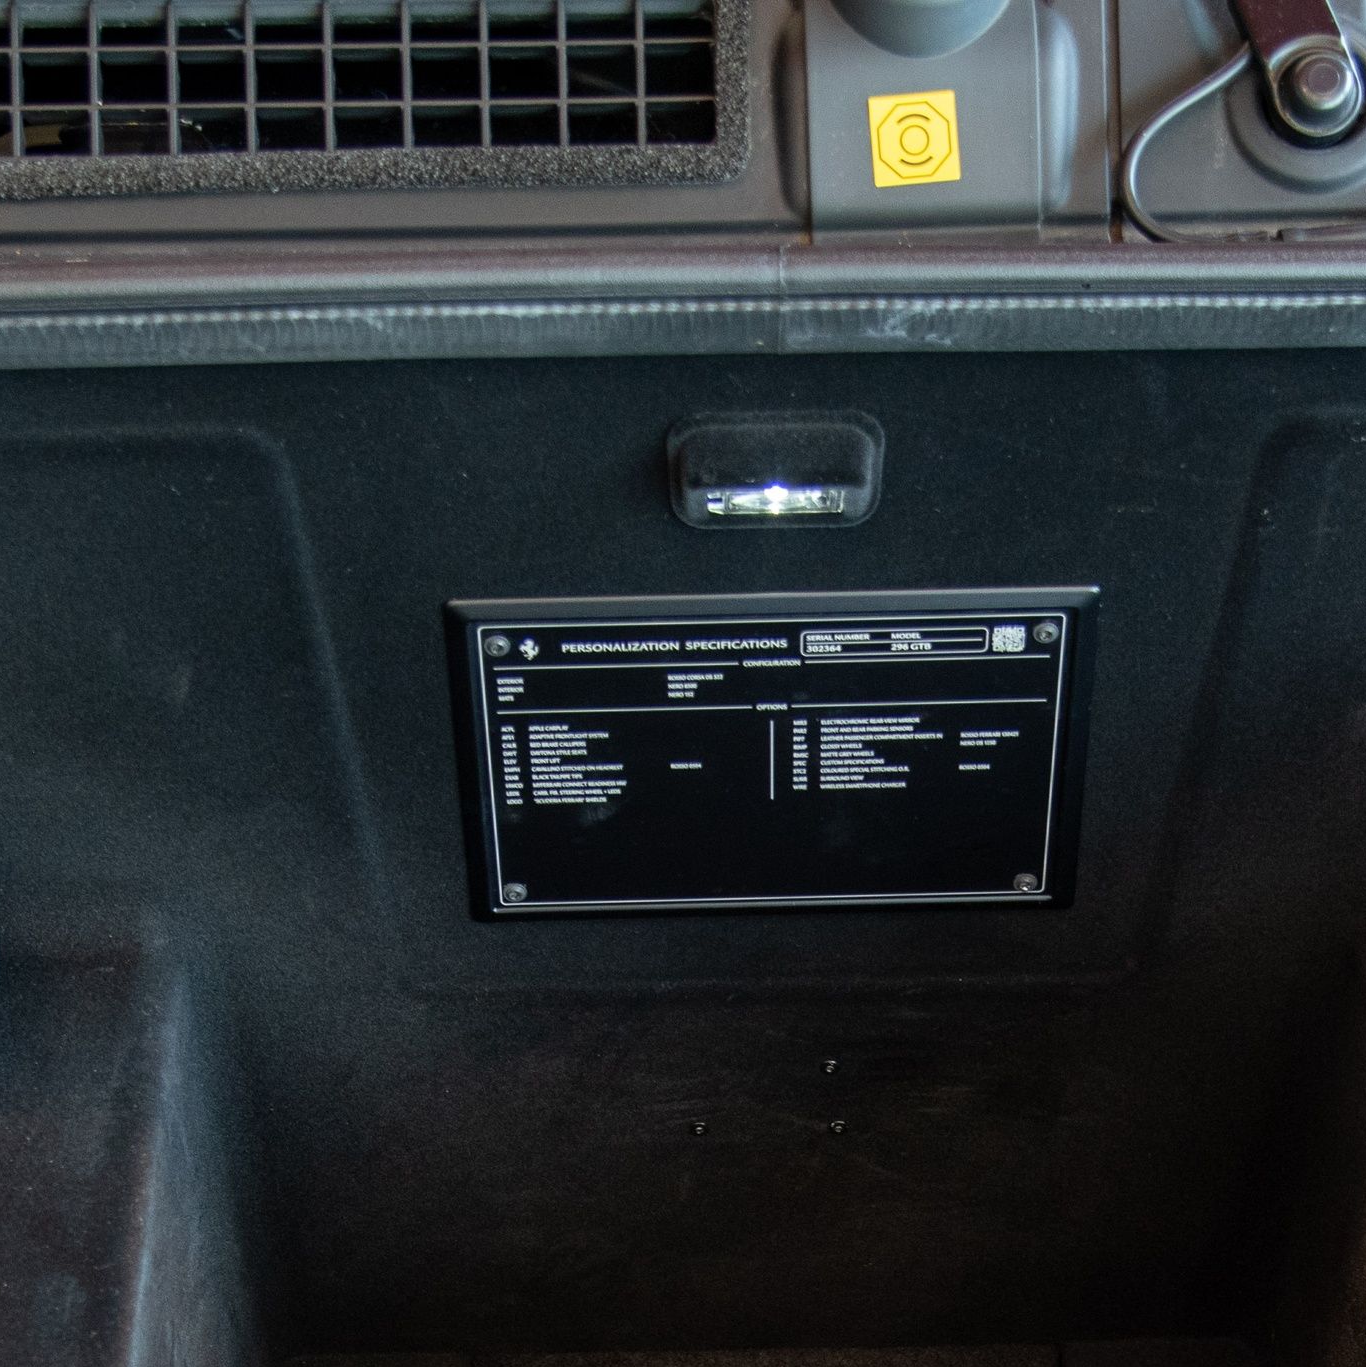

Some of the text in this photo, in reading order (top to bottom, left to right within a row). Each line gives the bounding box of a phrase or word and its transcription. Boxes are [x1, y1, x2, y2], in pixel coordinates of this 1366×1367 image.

[806, 632, 870, 641] SERIAL NUMBER
[891, 632, 921, 640] MODEL
[561, 639, 788, 654] PERSONALIZATION SPECIFICATIONS
[891, 643, 931, 651] 296 GTB
[743, 658, 802, 668] CONFIGURATION
[498, 686, 524, 694] INTERIOR
[756, 703, 788, 711] OPTIONS
